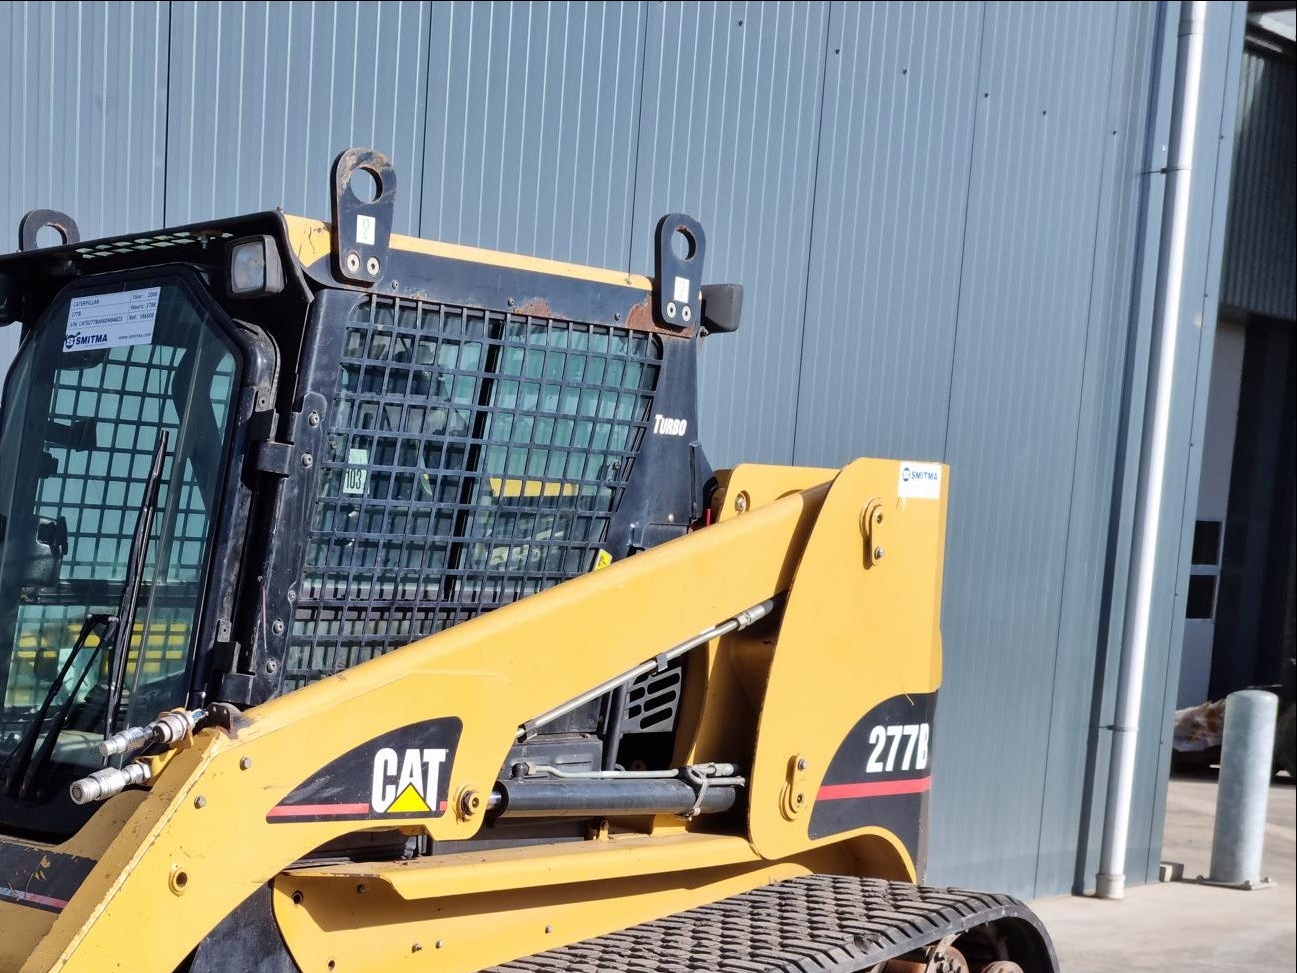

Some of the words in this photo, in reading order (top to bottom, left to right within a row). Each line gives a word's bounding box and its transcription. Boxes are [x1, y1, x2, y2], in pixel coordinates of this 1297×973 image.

[73, 299, 99, 308] CATERPILLAR
[75, 334, 108, 345] SMITMA
[346, 469, 362, 490] 103
[910, 471, 938, 481] SMITMA
[865, 722, 931, 774] 277B
[371, 747, 447, 814] CAT
